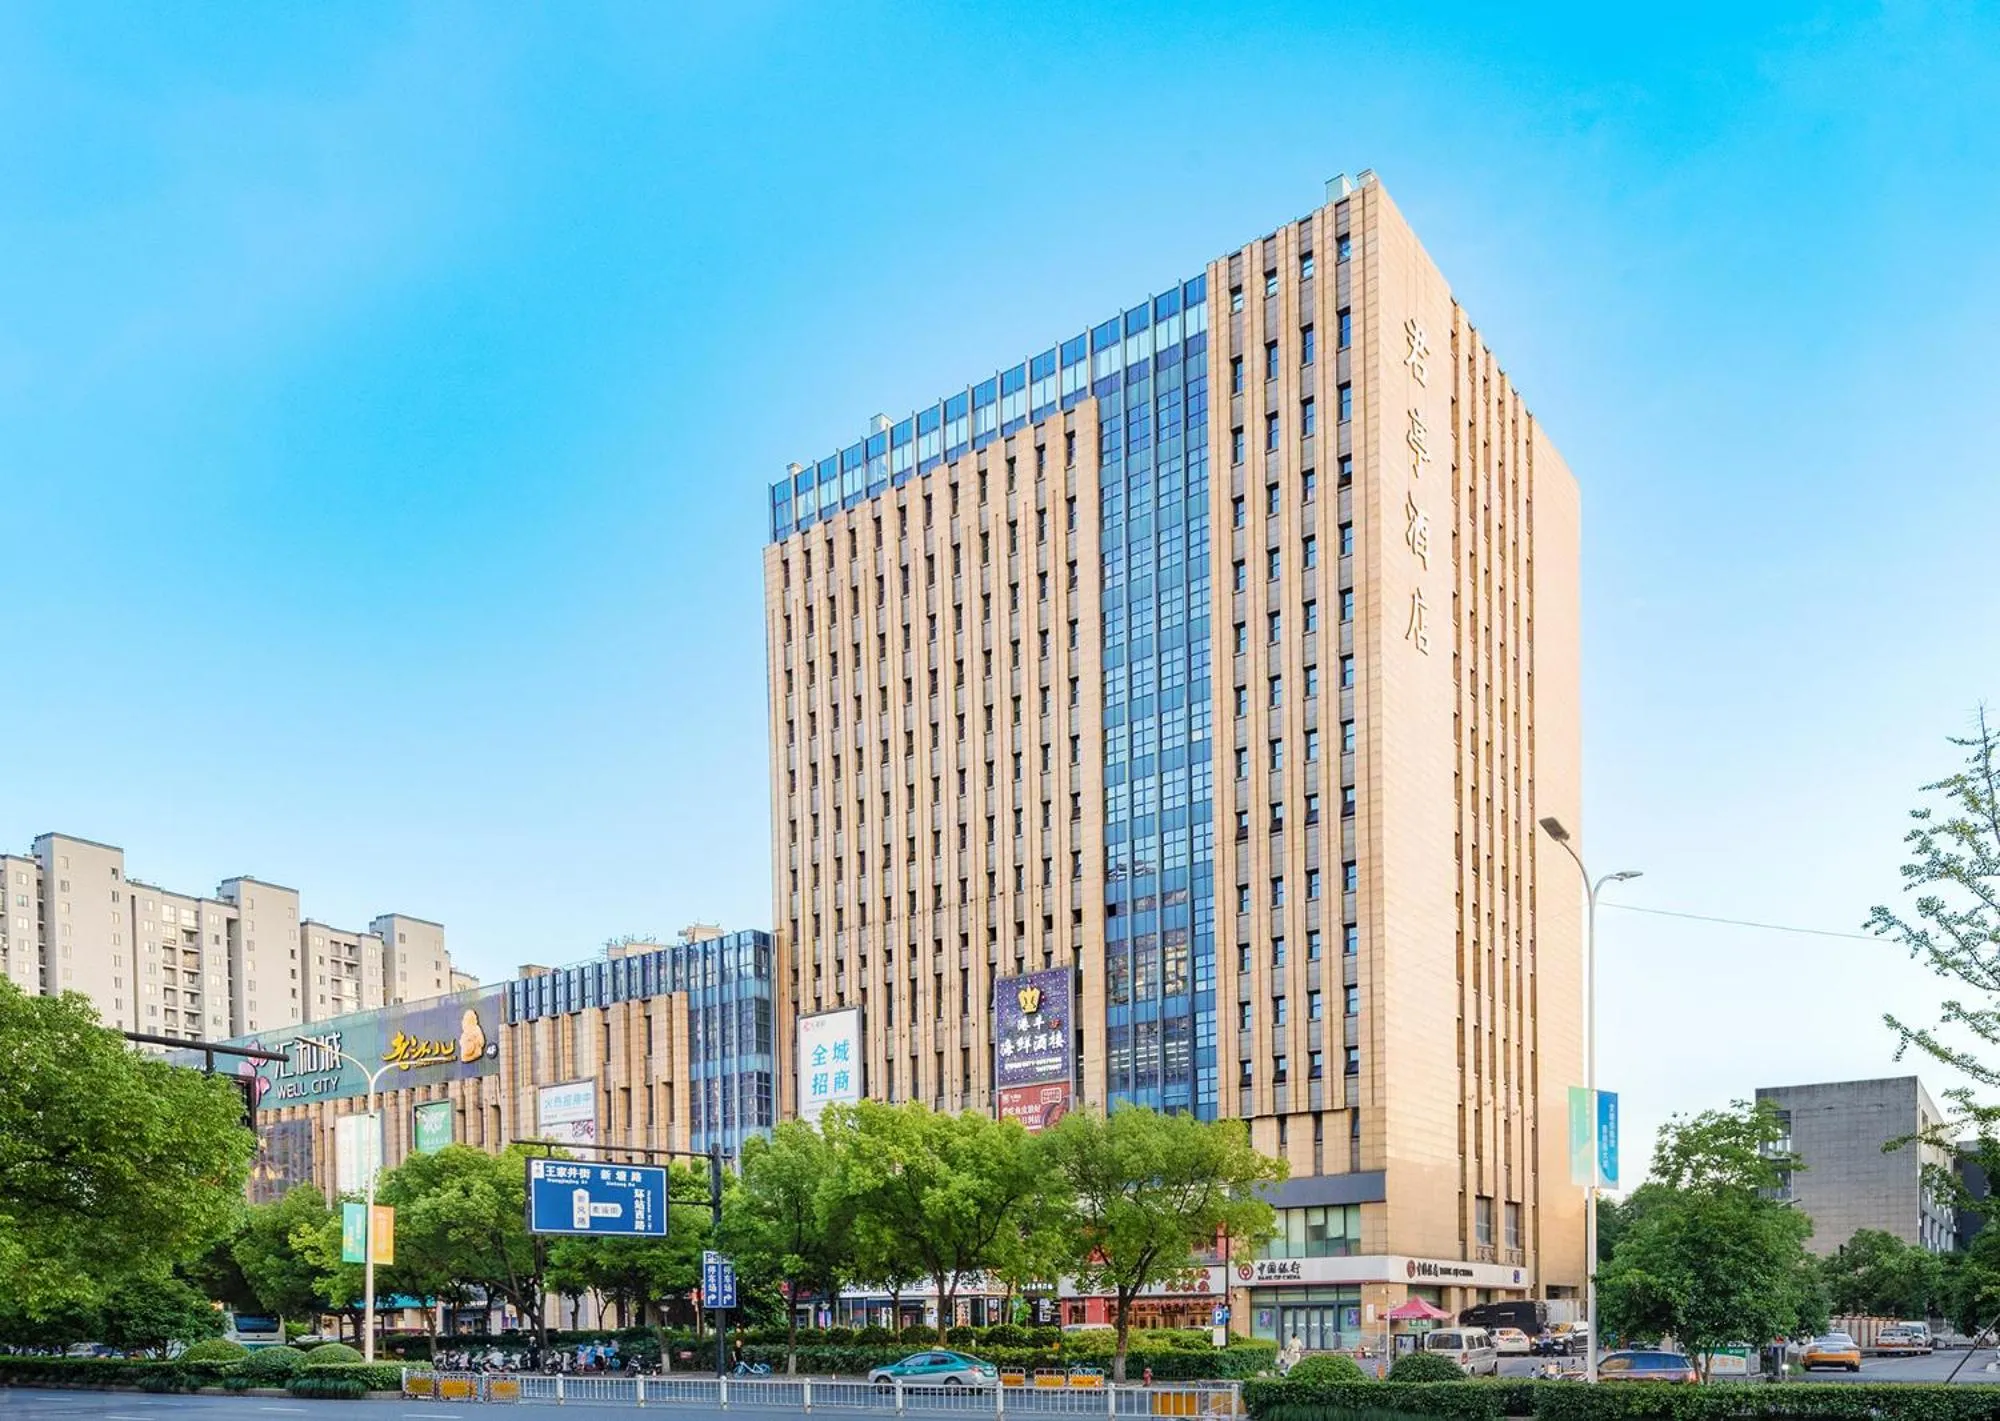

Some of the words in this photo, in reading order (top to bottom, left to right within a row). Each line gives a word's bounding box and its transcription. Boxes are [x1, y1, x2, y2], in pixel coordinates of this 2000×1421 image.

[811, 1038, 850, 1066] 全城
[277, 1081, 309, 1100] WELL
[311, 1076, 339, 1094] CITY
[811, 1069, 850, 1096] 招商
[708, 1265, 717, 1293] 停车场
[1258, 1261, 1301, 1275] 中国银行
